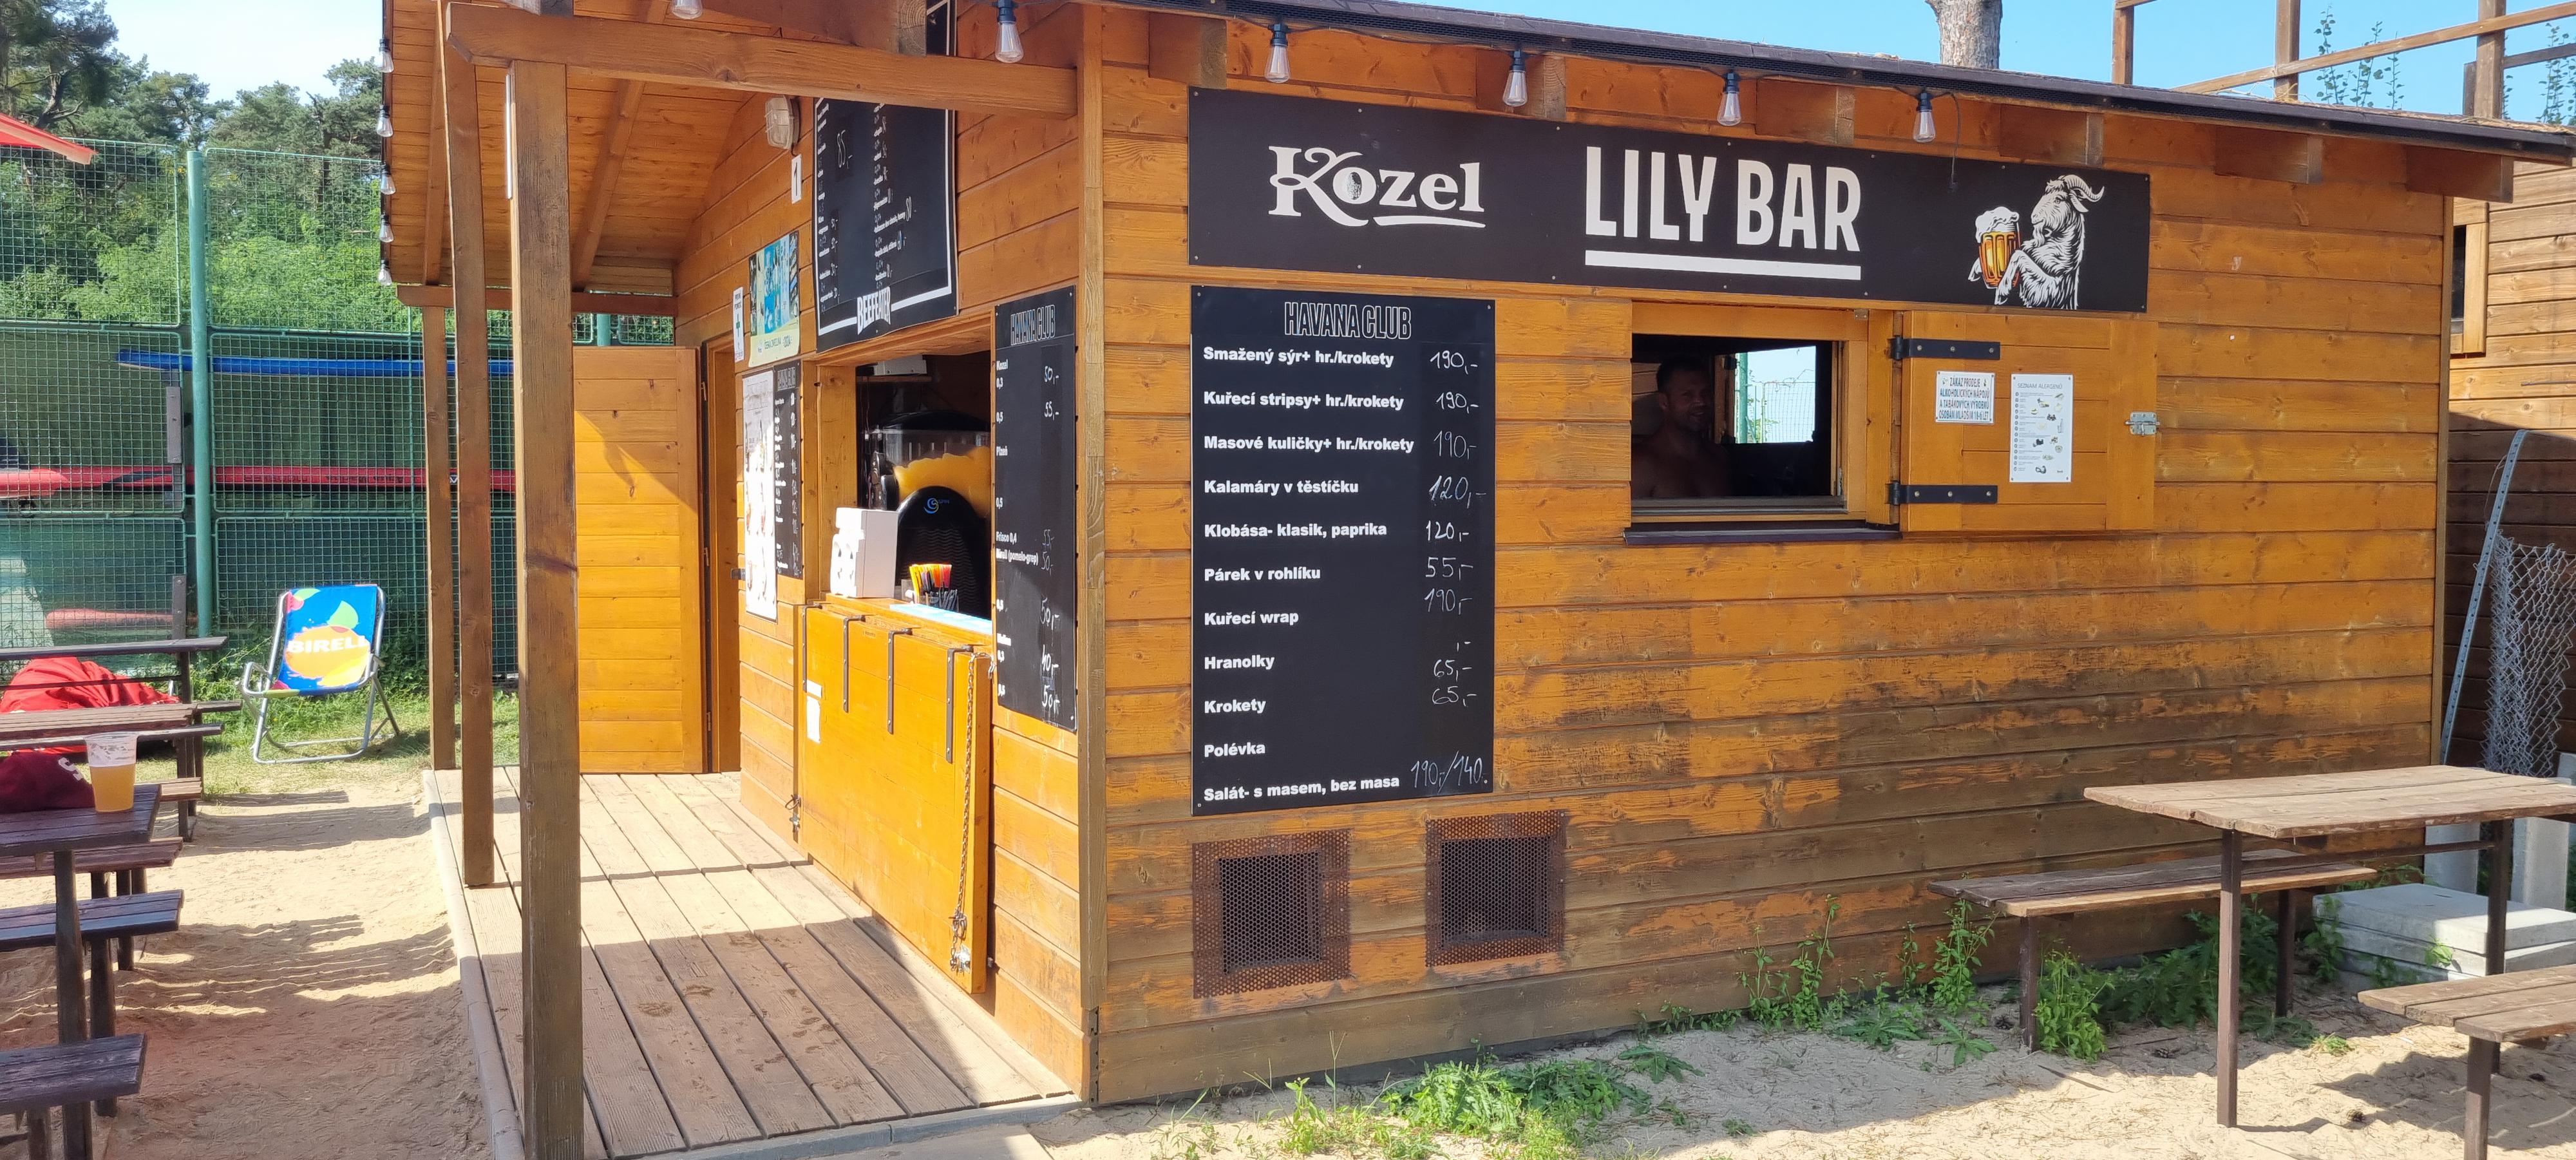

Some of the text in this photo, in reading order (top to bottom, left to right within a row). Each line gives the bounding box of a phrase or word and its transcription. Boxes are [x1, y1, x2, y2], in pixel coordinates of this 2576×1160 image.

[1269, 146, 1485, 227] Kozel
[1586, 146, 1861, 251] LILY BAR
[857, 286, 891, 336] BEEFEATER
[1285, 302, 1411, 339] HAVANA CLUB
[1010, 305, 1056, 346] HAVANA CLUB
[996, 359, 1008, 370] Kozel
[1204, 347, 1477, 374] Smažený sýr+ hr./krokety 190,-
[1045, 366, 1059, 384] 50,-
[1045, 401, 1059, 420] 55,-
[1204, 392, 1479, 414] Kuřecí stripsy+ hr./krokety 190,-
[1204, 431, 1476, 459] Masové kuličky+ hr./krokety 190,-
[1205, 475, 1486, 509] Kalamáry v těstíčku 120,-
[1205, 520, 1469, 542] Klobása- klasik, paprika 120,-
[1205, 557, 1473, 581] Párek v rohlíku 55,-
[1205, 611, 1298, 625] Kuřecí wrap
[288, 636, 369, 653] BIRELL
[1205, 654, 1472, 681] Hranolky 65,-
[1205, 699, 1266, 714] Krokety
[1204, 742, 1265, 757] Polévka
[1204, 786, 1249, 801] Salát-
[1254, 788, 1262, 797] s
[1267, 783, 1326, 796] masem,
[1331, 779, 1356, 792] bez
[1361, 777, 1399, 789] masa
